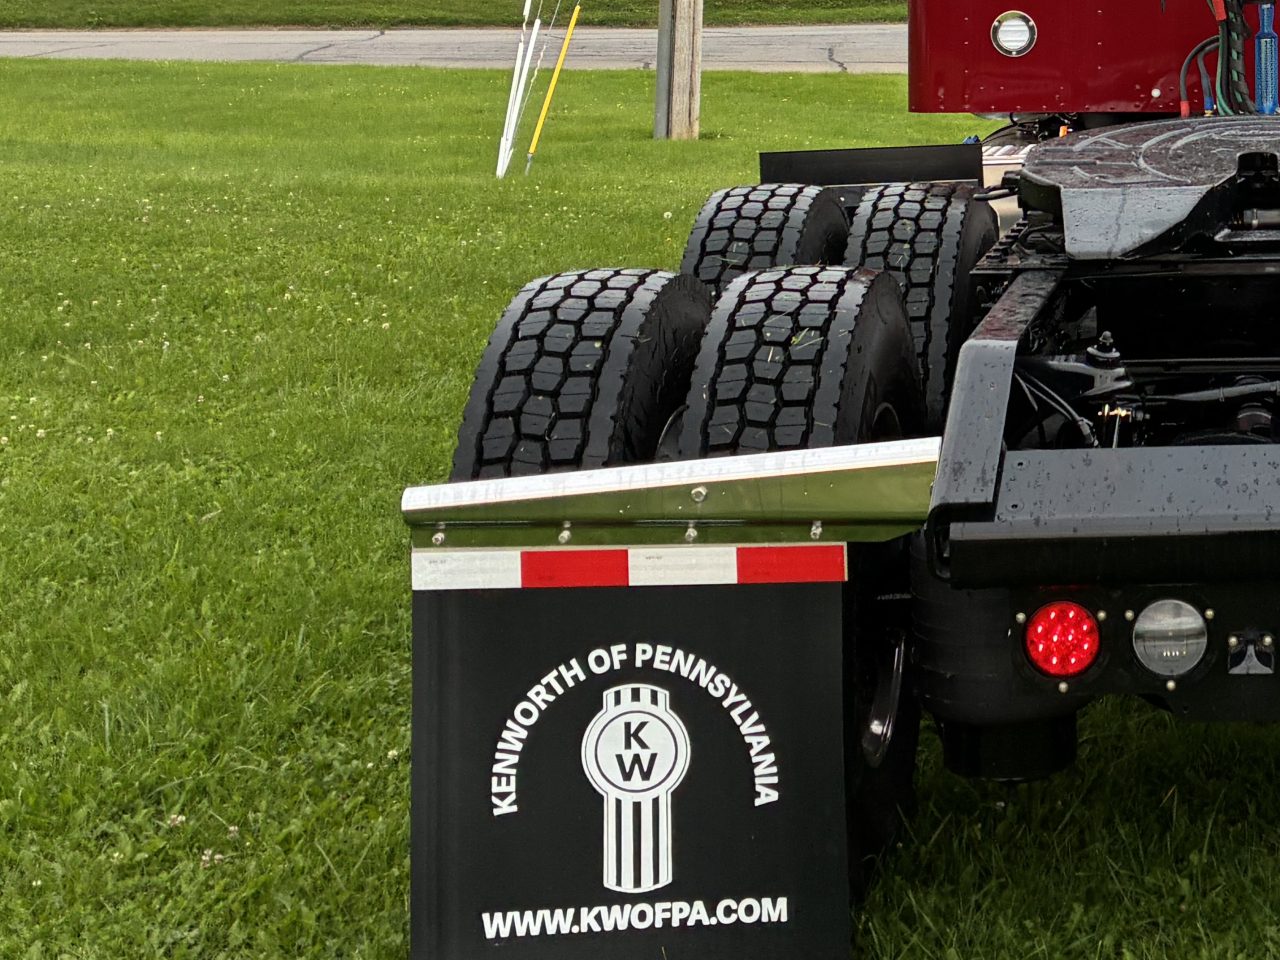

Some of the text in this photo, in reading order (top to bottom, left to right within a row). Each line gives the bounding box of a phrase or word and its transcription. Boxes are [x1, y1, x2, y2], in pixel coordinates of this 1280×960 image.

[491, 642, 779, 816] KENWORTH OF PENNSYLVANIA
[624, 721, 650, 750] K
[615, 752, 658, 782] W
[482, 896, 788, 939] WWW.KWOFPA.COM
